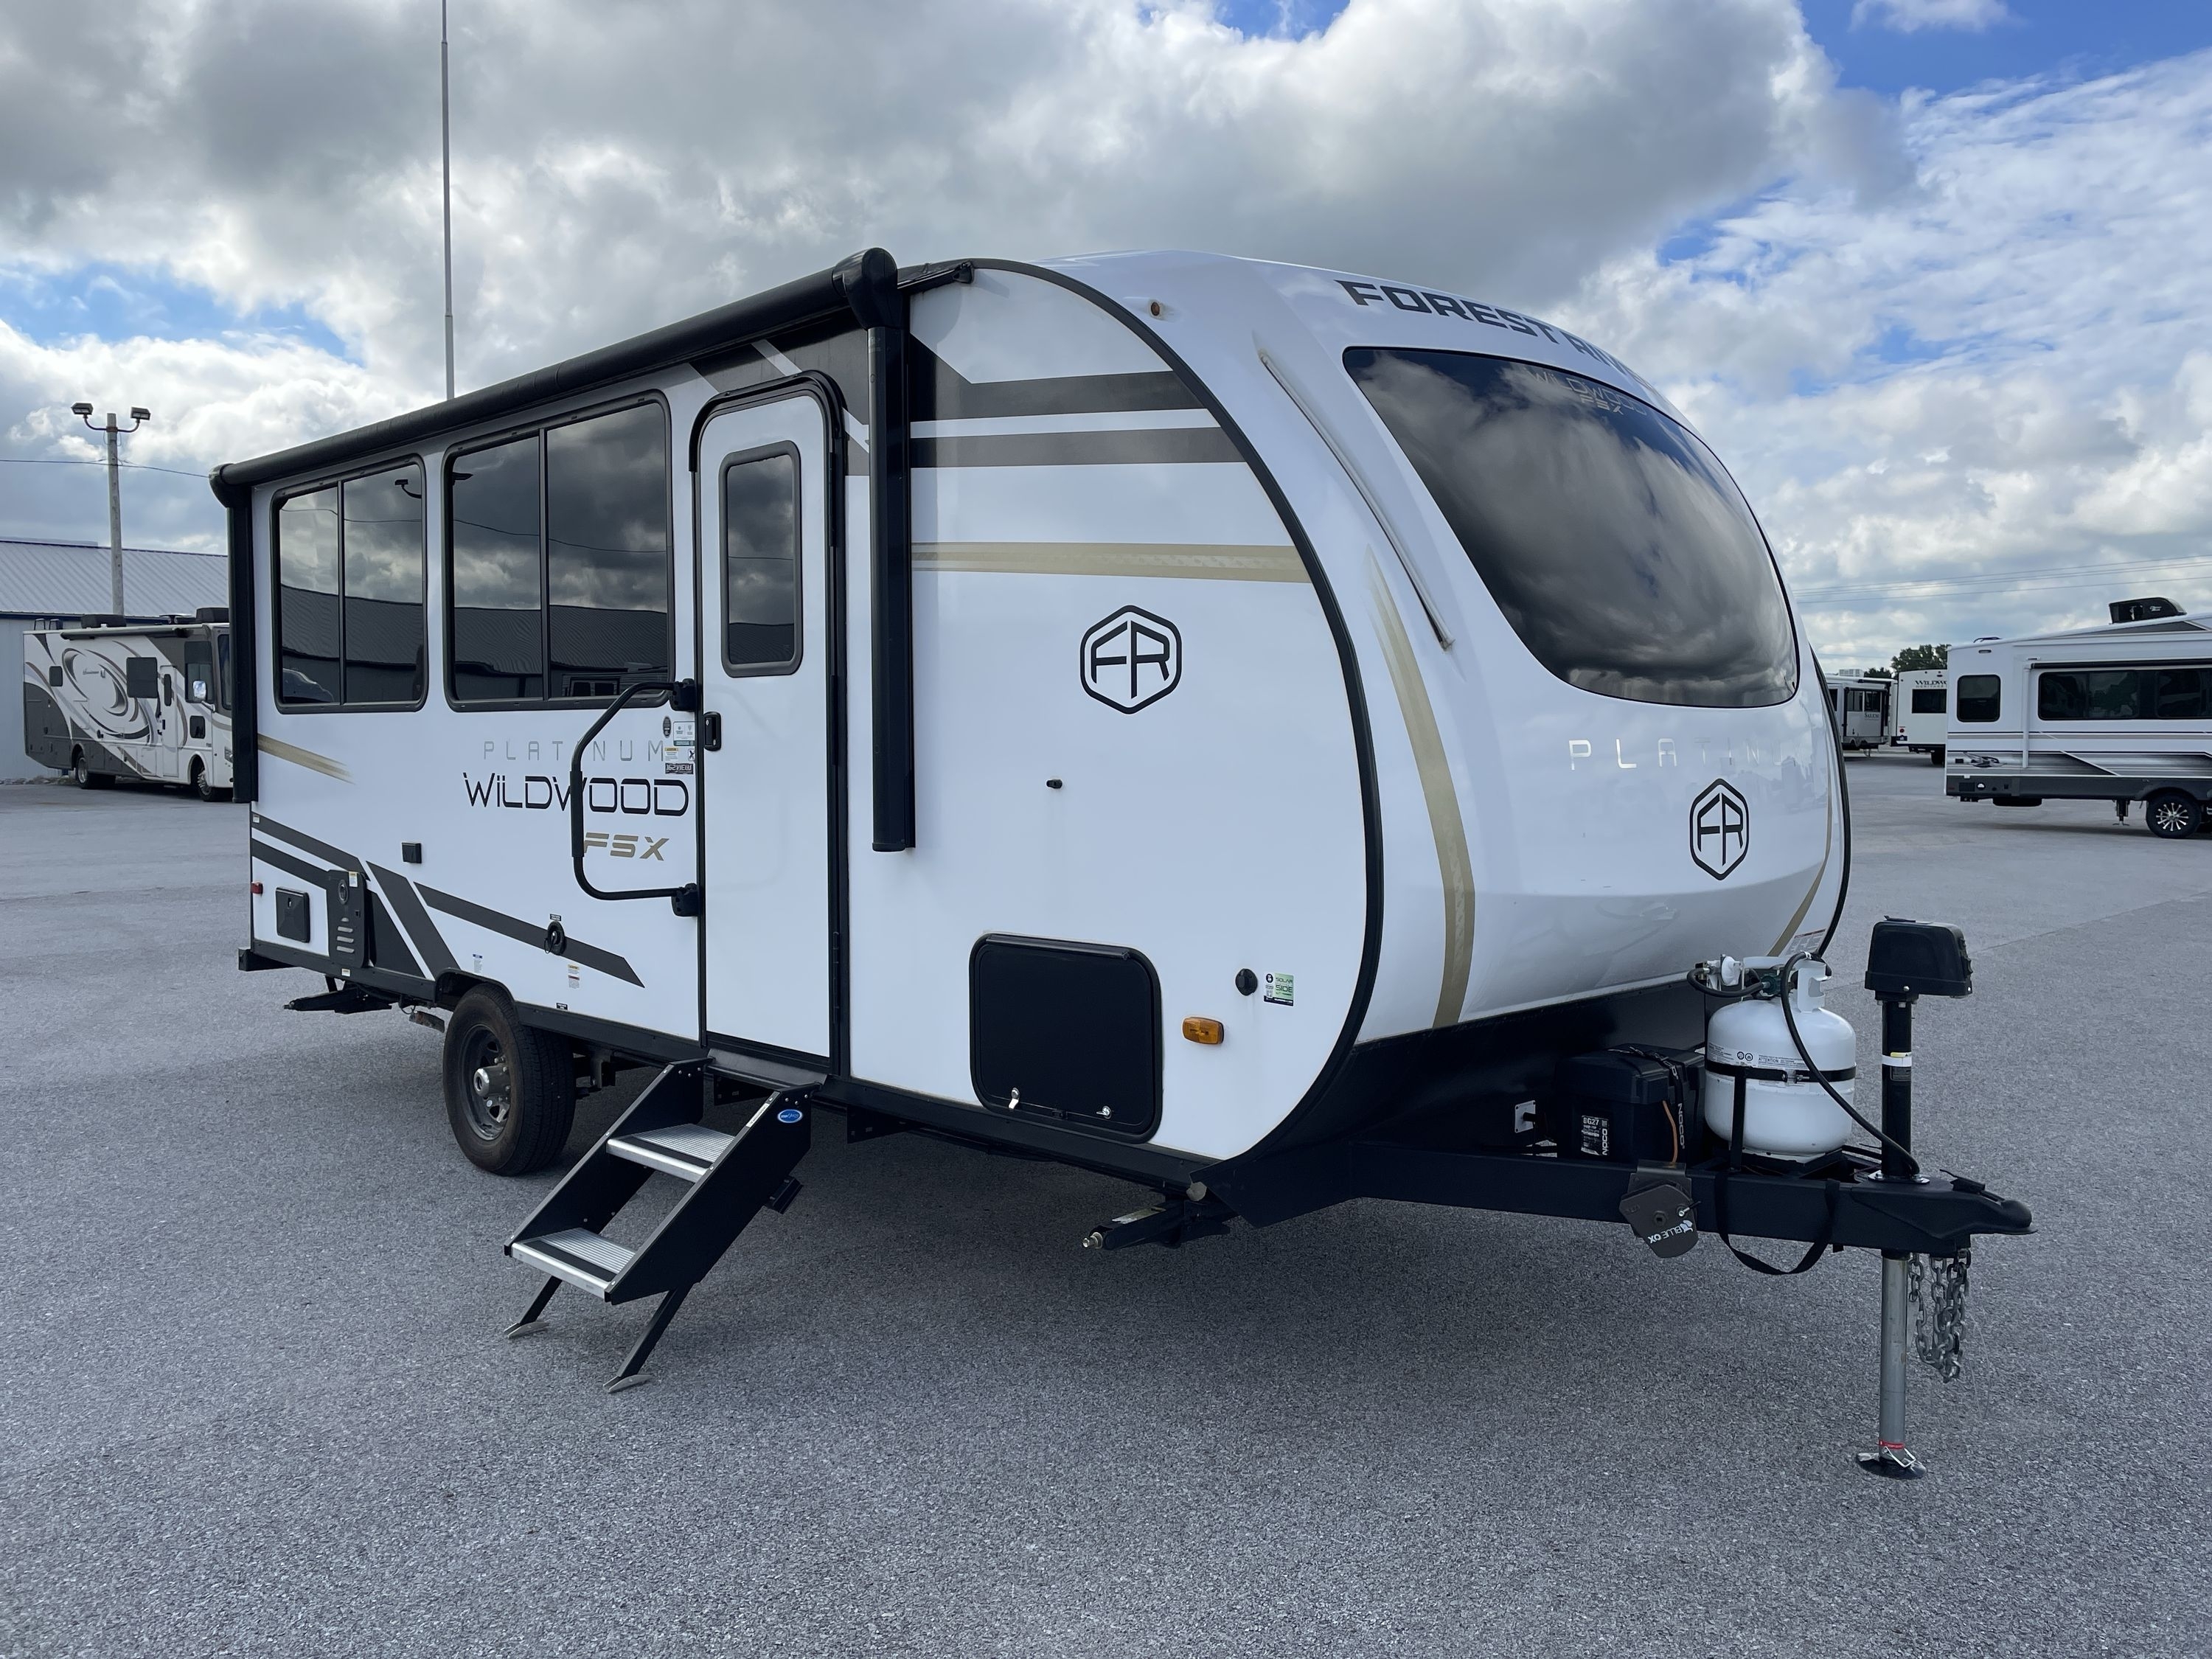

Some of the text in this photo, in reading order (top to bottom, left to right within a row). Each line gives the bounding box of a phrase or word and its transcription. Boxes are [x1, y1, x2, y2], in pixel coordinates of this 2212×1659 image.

[1334, 279, 1559, 344] FOREST
[484, 740, 664, 761] PLATNUM
[583, 831, 670, 862] FSX
[1647, 1225, 1682, 1244] BLUE OX
